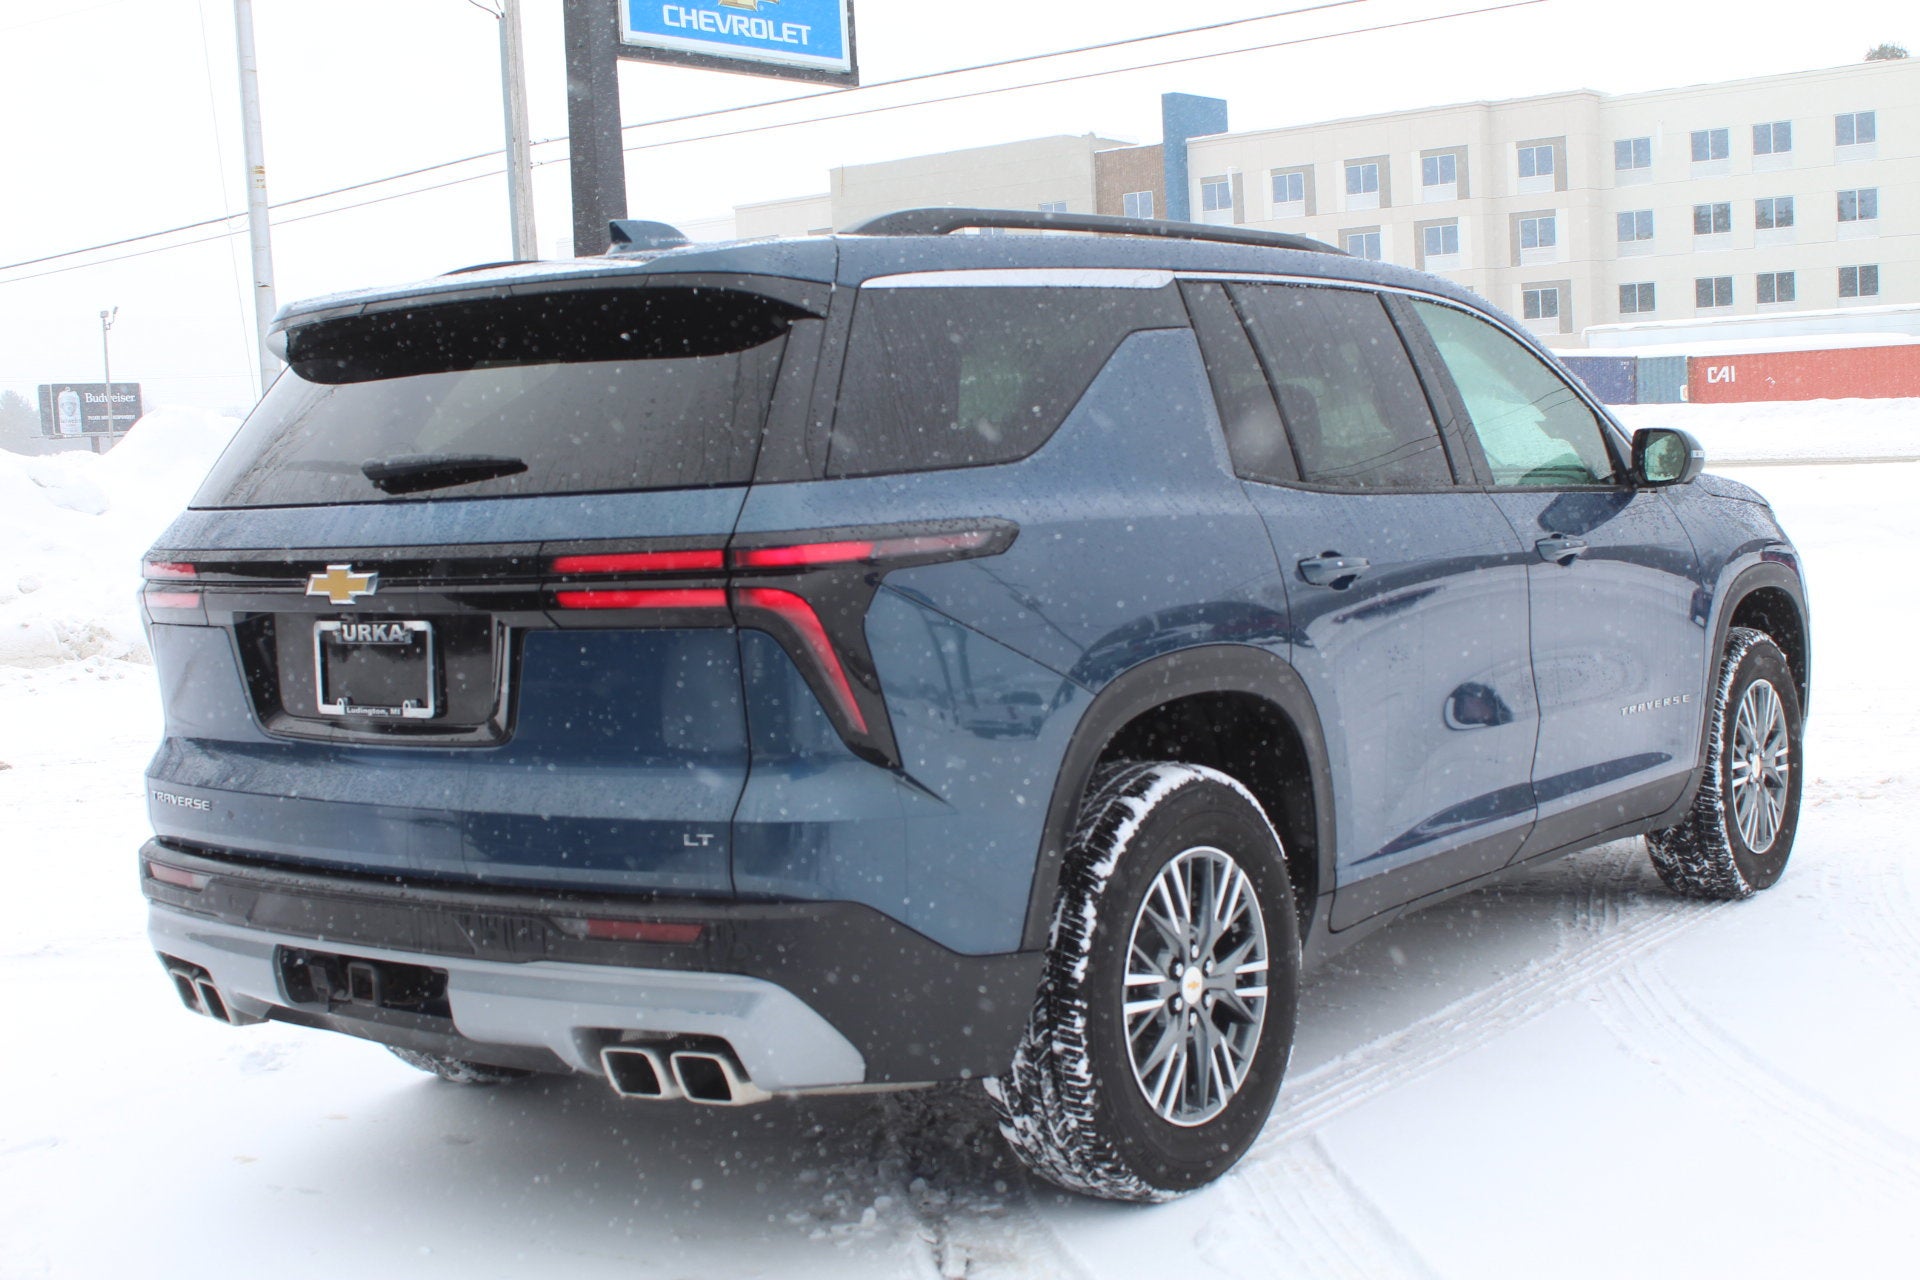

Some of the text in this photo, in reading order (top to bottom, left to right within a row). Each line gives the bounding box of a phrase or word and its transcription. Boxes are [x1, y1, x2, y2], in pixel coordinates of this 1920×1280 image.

[662, 5, 811, 45] CHEVROLET
[1707, 365, 1736, 384] CAI
[341, 623, 404, 642] URKA
[1620, 694, 1691, 716] TRAVERSE
[151, 790, 211, 811] TRAVERSE
[683, 833, 714, 846] LT
